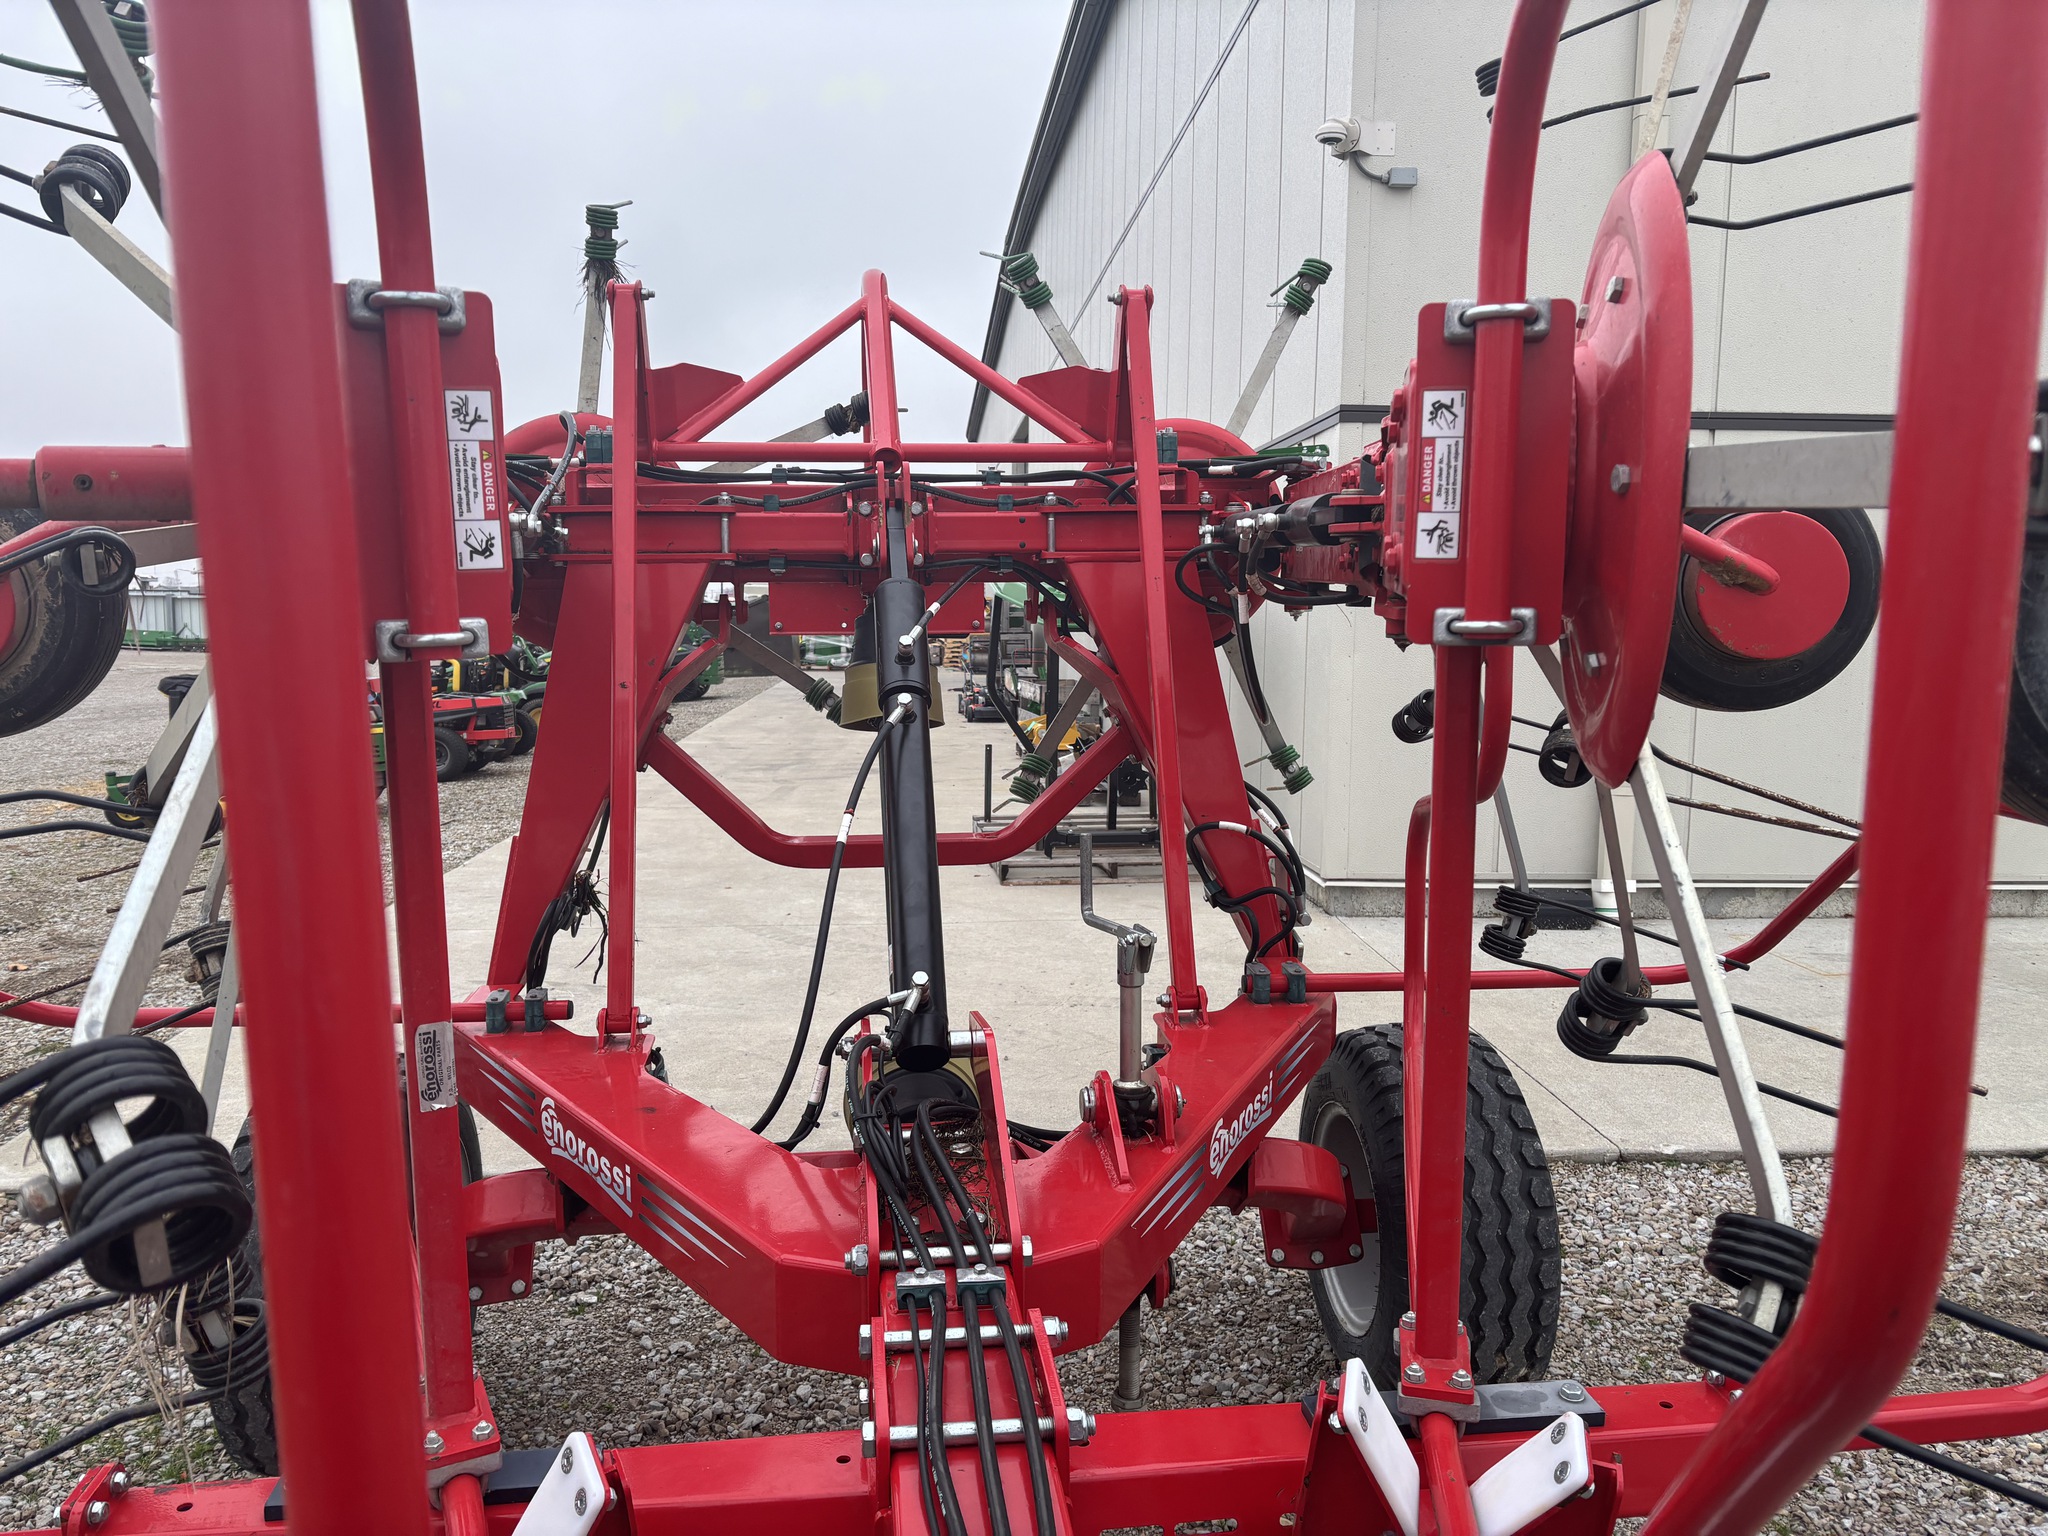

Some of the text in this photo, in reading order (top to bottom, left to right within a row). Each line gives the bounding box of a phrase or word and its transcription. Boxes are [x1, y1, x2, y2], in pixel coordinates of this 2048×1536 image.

[470, 457, 478, 472] Stay
[483, 462, 496, 511] DANGER
[1422, 446, 1433, 492] DANGER
[456, 493, 464, 518] objects
[462, 468, 472, 514] entanglement
[418, 1031, 439, 1102] enorossi
[1210, 1070, 1273, 1175] enorossi
[540, 1096, 633, 1205] enorossi
